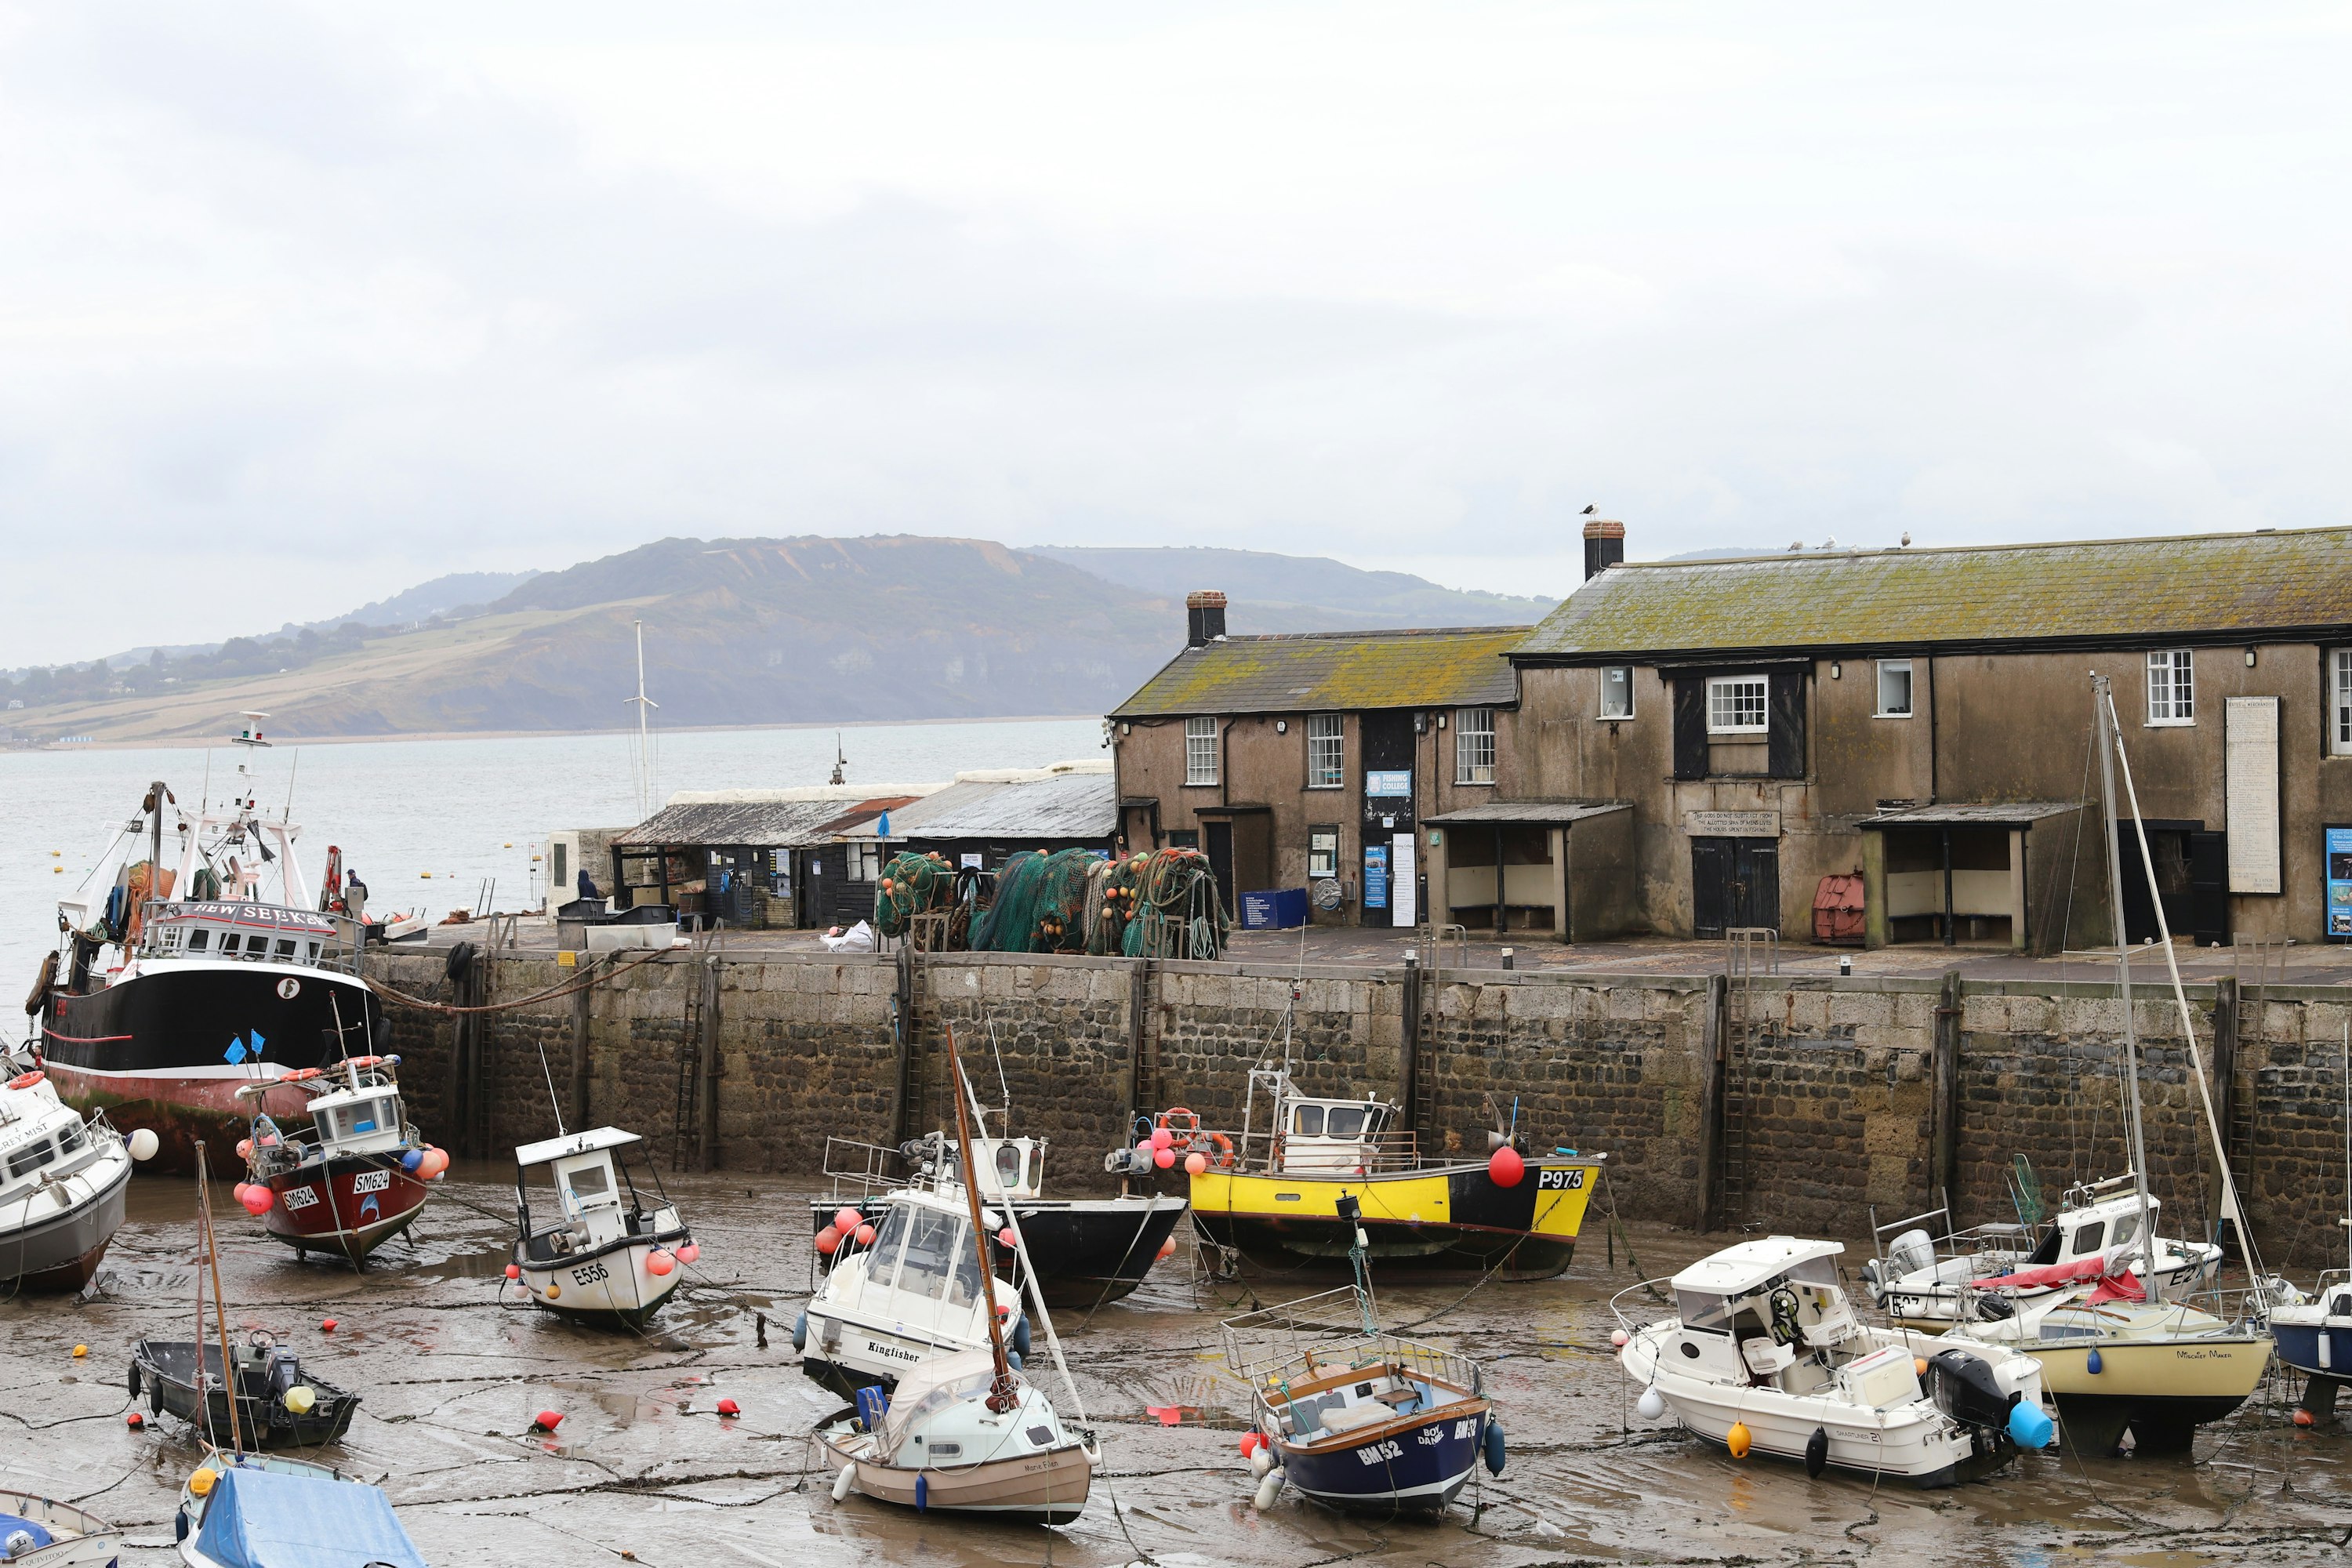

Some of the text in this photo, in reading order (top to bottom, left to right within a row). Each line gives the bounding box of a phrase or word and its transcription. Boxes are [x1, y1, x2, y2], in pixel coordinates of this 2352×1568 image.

[1382, 774, 1408, 782] FISHING
[193, 904, 328, 927] NEW SEEKER
[24, 1122, 48, 1138] MIST
[355, 1171, 389, 1192] SM624
[1538, 1171, 1584, 1189] P975
[283, 1189, 316, 1209] SM624
[2107, 1204, 2122, 1213] QUO
[571, 1262, 609, 1287] E556
[1980, 1304, 2002, 1319] MERCURY
[868, 1341, 920, 1363] Kingfisher
[1948, 1352, 1966, 1360] 100
[1417, 1429, 1445, 1446] DANIEL
[1423, 1424, 1440, 1437] BOY
[1870, 1432, 1882, 1443] 21
[1024, 1460, 1059, 1472] Marie Elen
